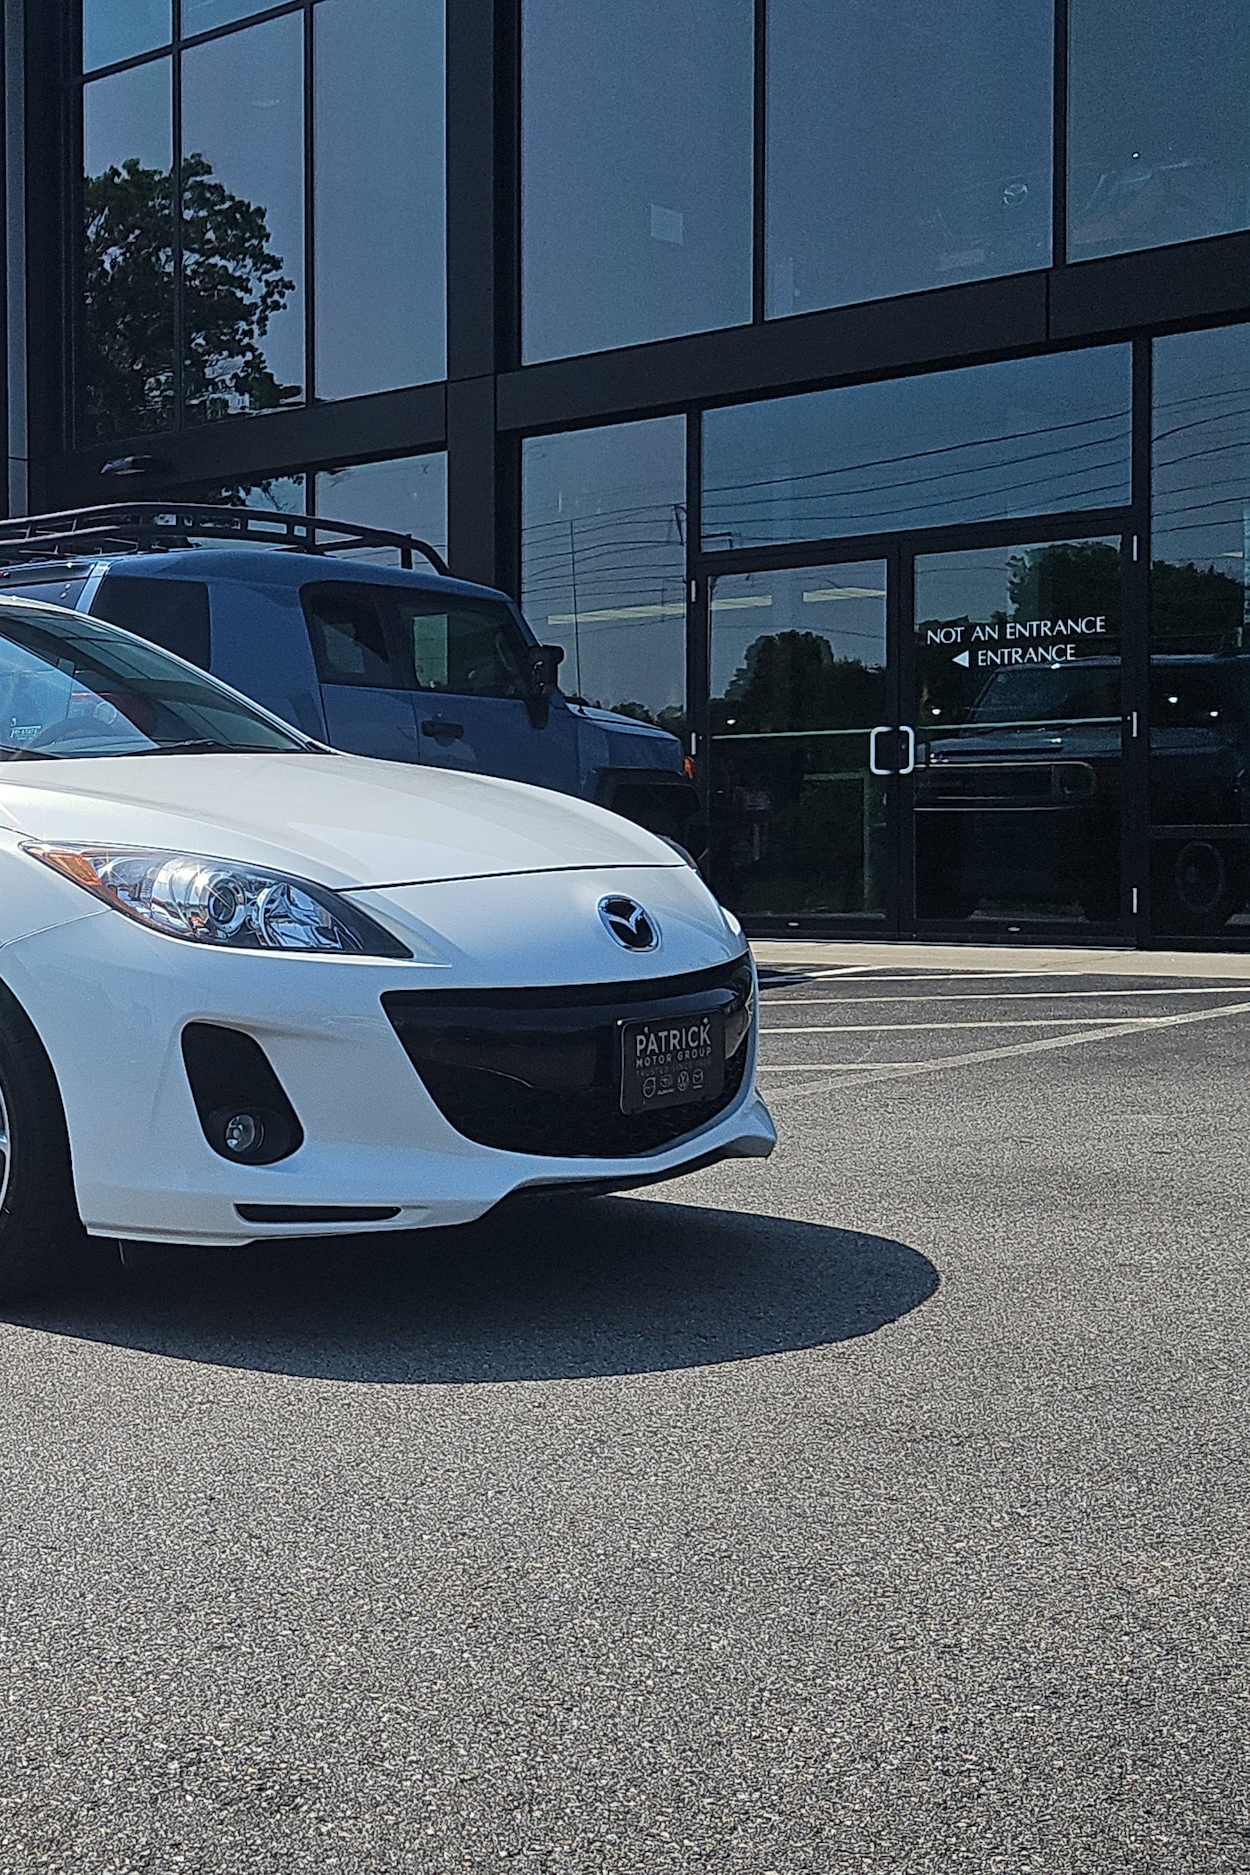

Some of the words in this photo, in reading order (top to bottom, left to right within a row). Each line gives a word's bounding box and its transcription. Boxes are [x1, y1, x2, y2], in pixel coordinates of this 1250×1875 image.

[926, 627, 965, 645] NOT
[971, 624, 999, 642] AN
[1006, 615, 1106, 640] ENTRANCE
[978, 644, 1076, 667] ENTRANCE
[635, 1023, 712, 1057] PATRICK
[635, 1053, 672, 1068] MOTOR
[677, 1046, 712, 1061] GROUP
